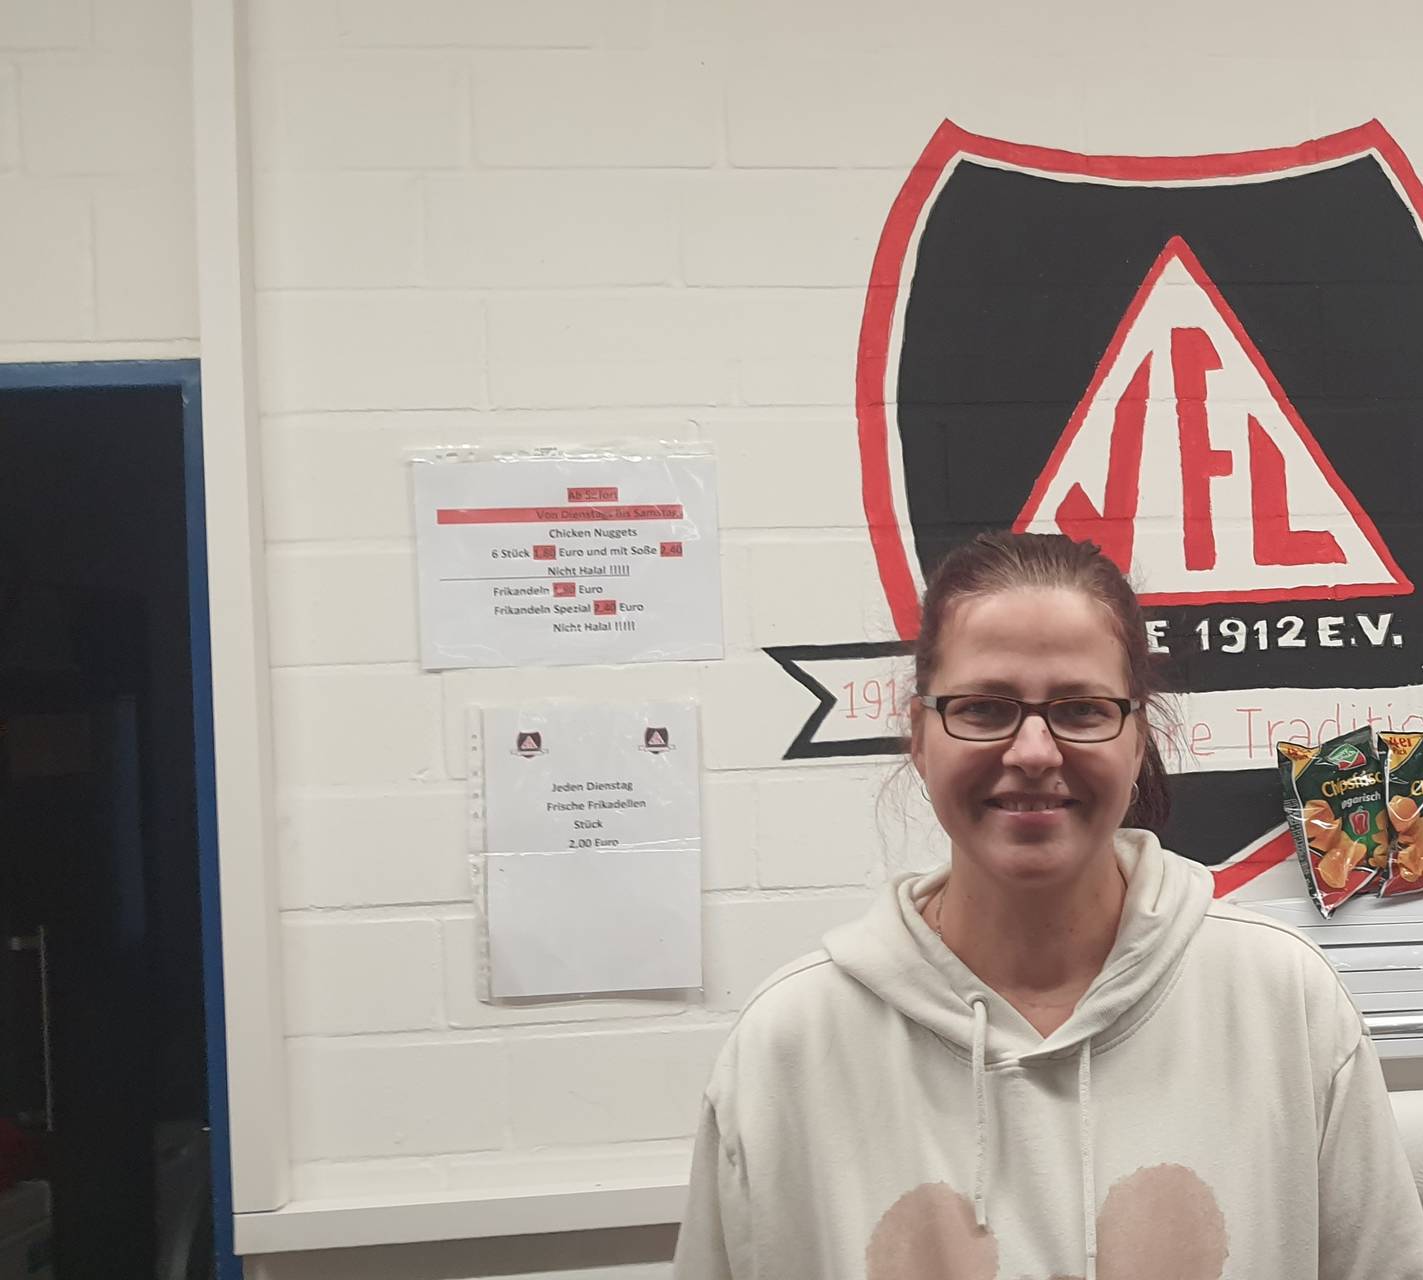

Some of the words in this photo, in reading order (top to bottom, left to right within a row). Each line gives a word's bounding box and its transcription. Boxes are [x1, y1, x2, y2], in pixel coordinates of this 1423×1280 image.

[1055, 327, 1348, 575] VFL
[536, 510, 558, 519] Von
[549, 528, 591, 538] Chicken
[594, 528, 637, 539] Nuggets
[491, 550, 498, 558] 6
[500, 549, 530, 558] Stück
[559, 549, 584, 557] Euro
[587, 547, 608, 556] und
[610, 547, 628, 555] mit
[631, 546, 657, 555] Soße
[548, 566, 576, 576] Nicht
[579, 565, 607, 575] Halal
[493, 586, 550, 596] Frikandeln
[579, 585, 603, 594] Euro
[494, 606, 551, 615] Frikandeln
[554, 604, 591, 615] Spezial
[619, 603, 644, 612] Euro
[553, 623, 581, 632] Nicht
[584, 622, 612, 631] Halal
[1195, 615, 1307, 653] 1912
[843, 679, 917, 719] 191
[552, 782, 584, 792] Jeden
[587, 780, 633, 792] Dienstag
[547, 801, 585, 812] Frische
[588, 799, 647, 810] Frikadellen
[574, 819, 603, 830] Stück
[595, 838, 619, 848] Euro
